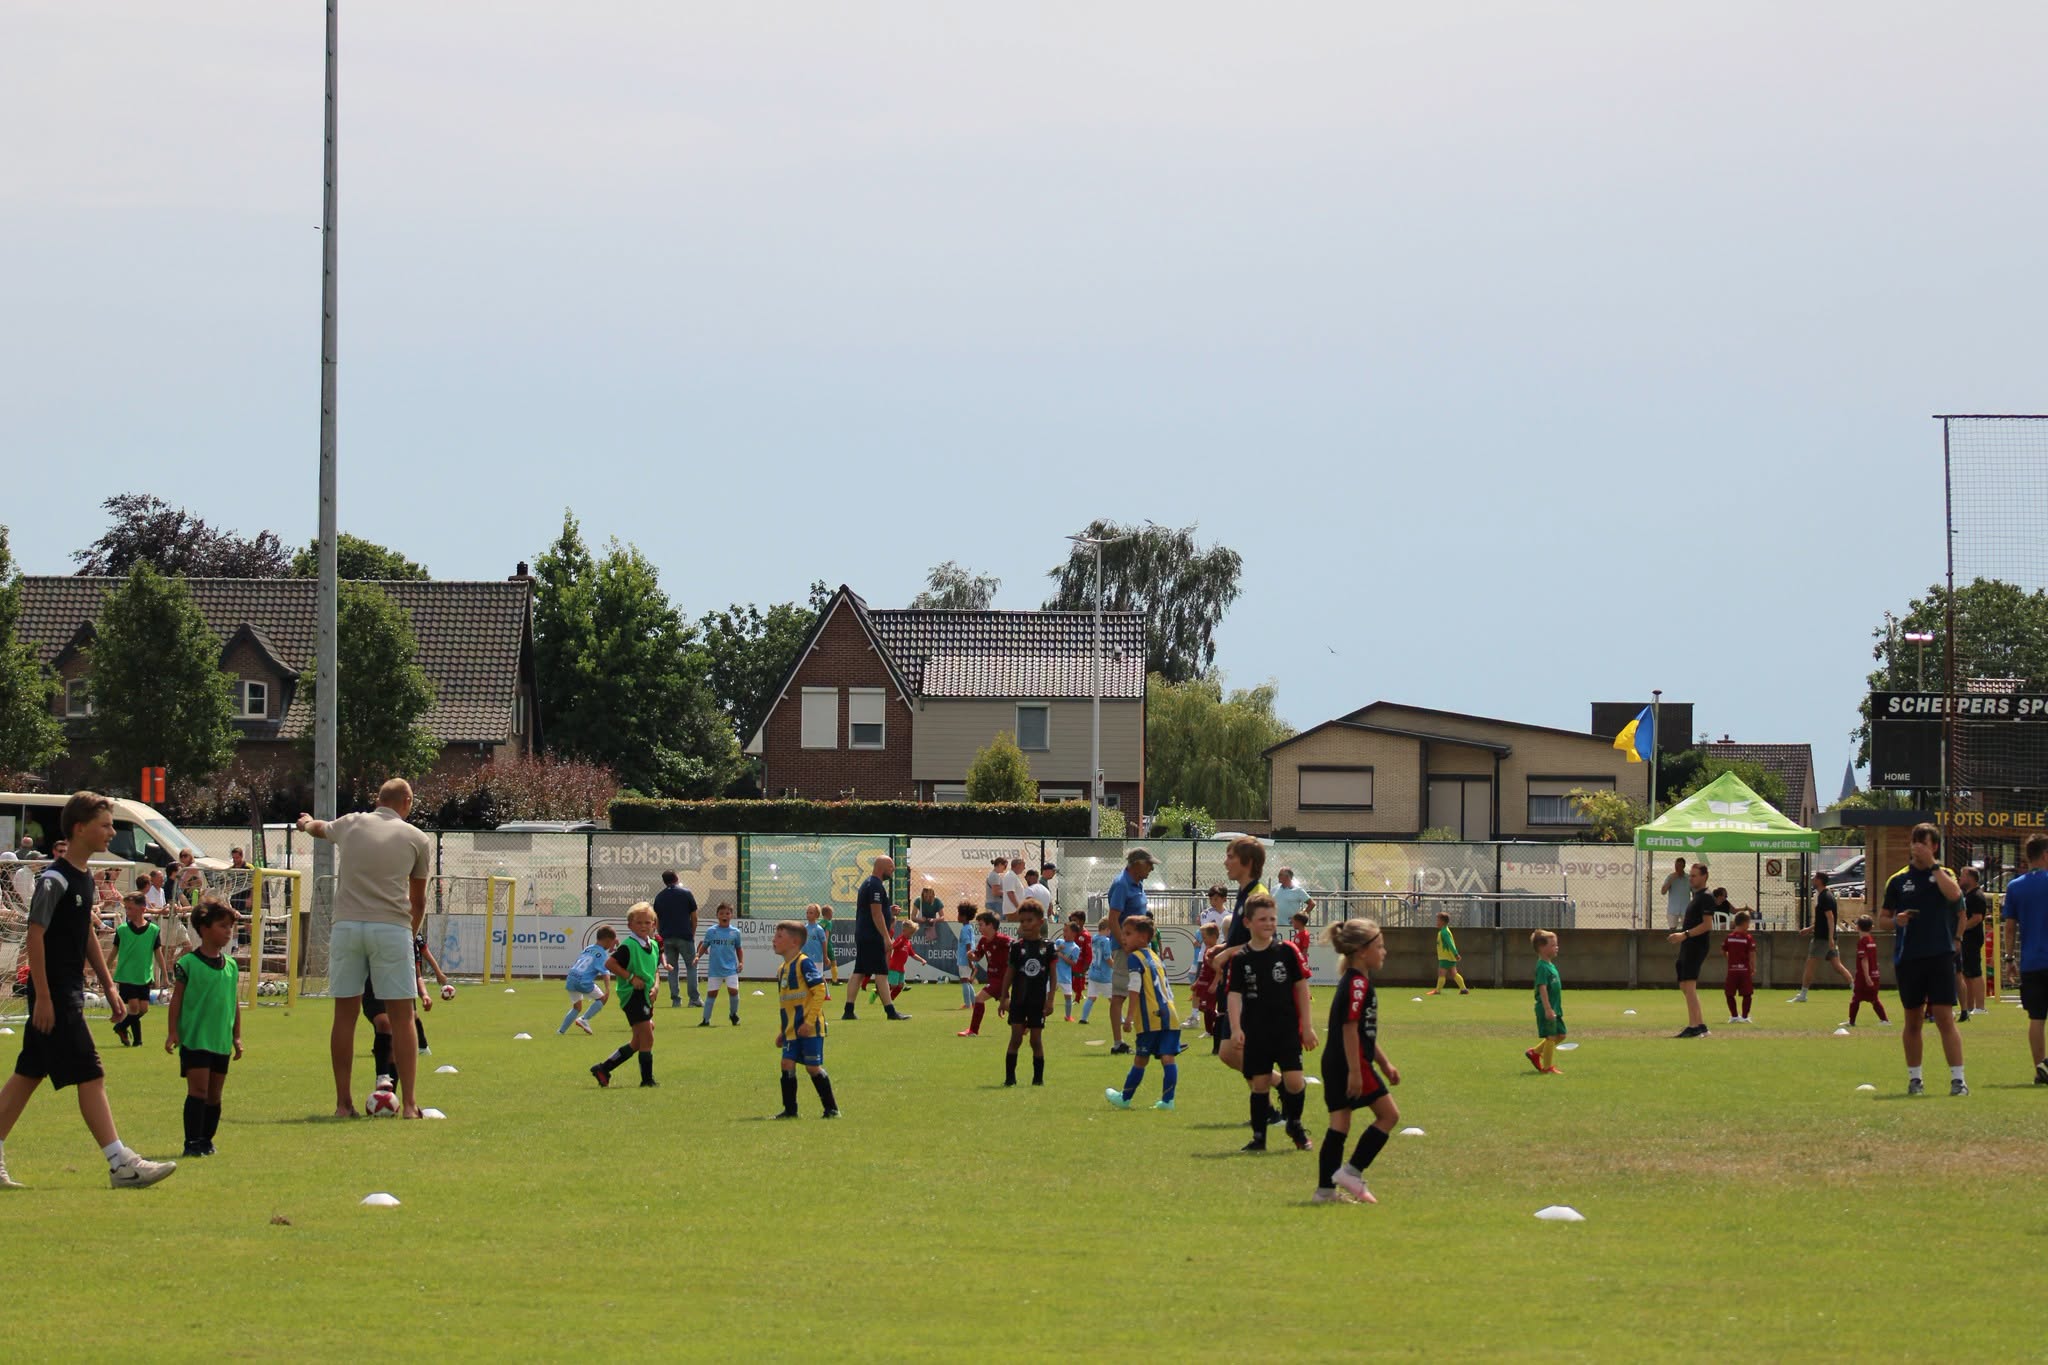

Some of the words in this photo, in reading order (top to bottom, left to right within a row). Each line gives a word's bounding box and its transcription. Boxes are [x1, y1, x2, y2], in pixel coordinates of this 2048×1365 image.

[2017, 698, 2048, 714] SP
[1884, 772, 1911, 782] HOME
[1690, 818, 1769, 831] erima
[1987, 811, 2010, 827] OP
[2013, 812, 2046, 827] IELE
[1646, 835, 1684, 847] erima
[1749, 839, 1811, 849] www.erima.eu
[492, 930, 566, 946] SjonPro
[830, 933, 856, 944] OLLUI
[831, 947, 857, 957] ERING
[928, 949, 958, 960] DEUREN
